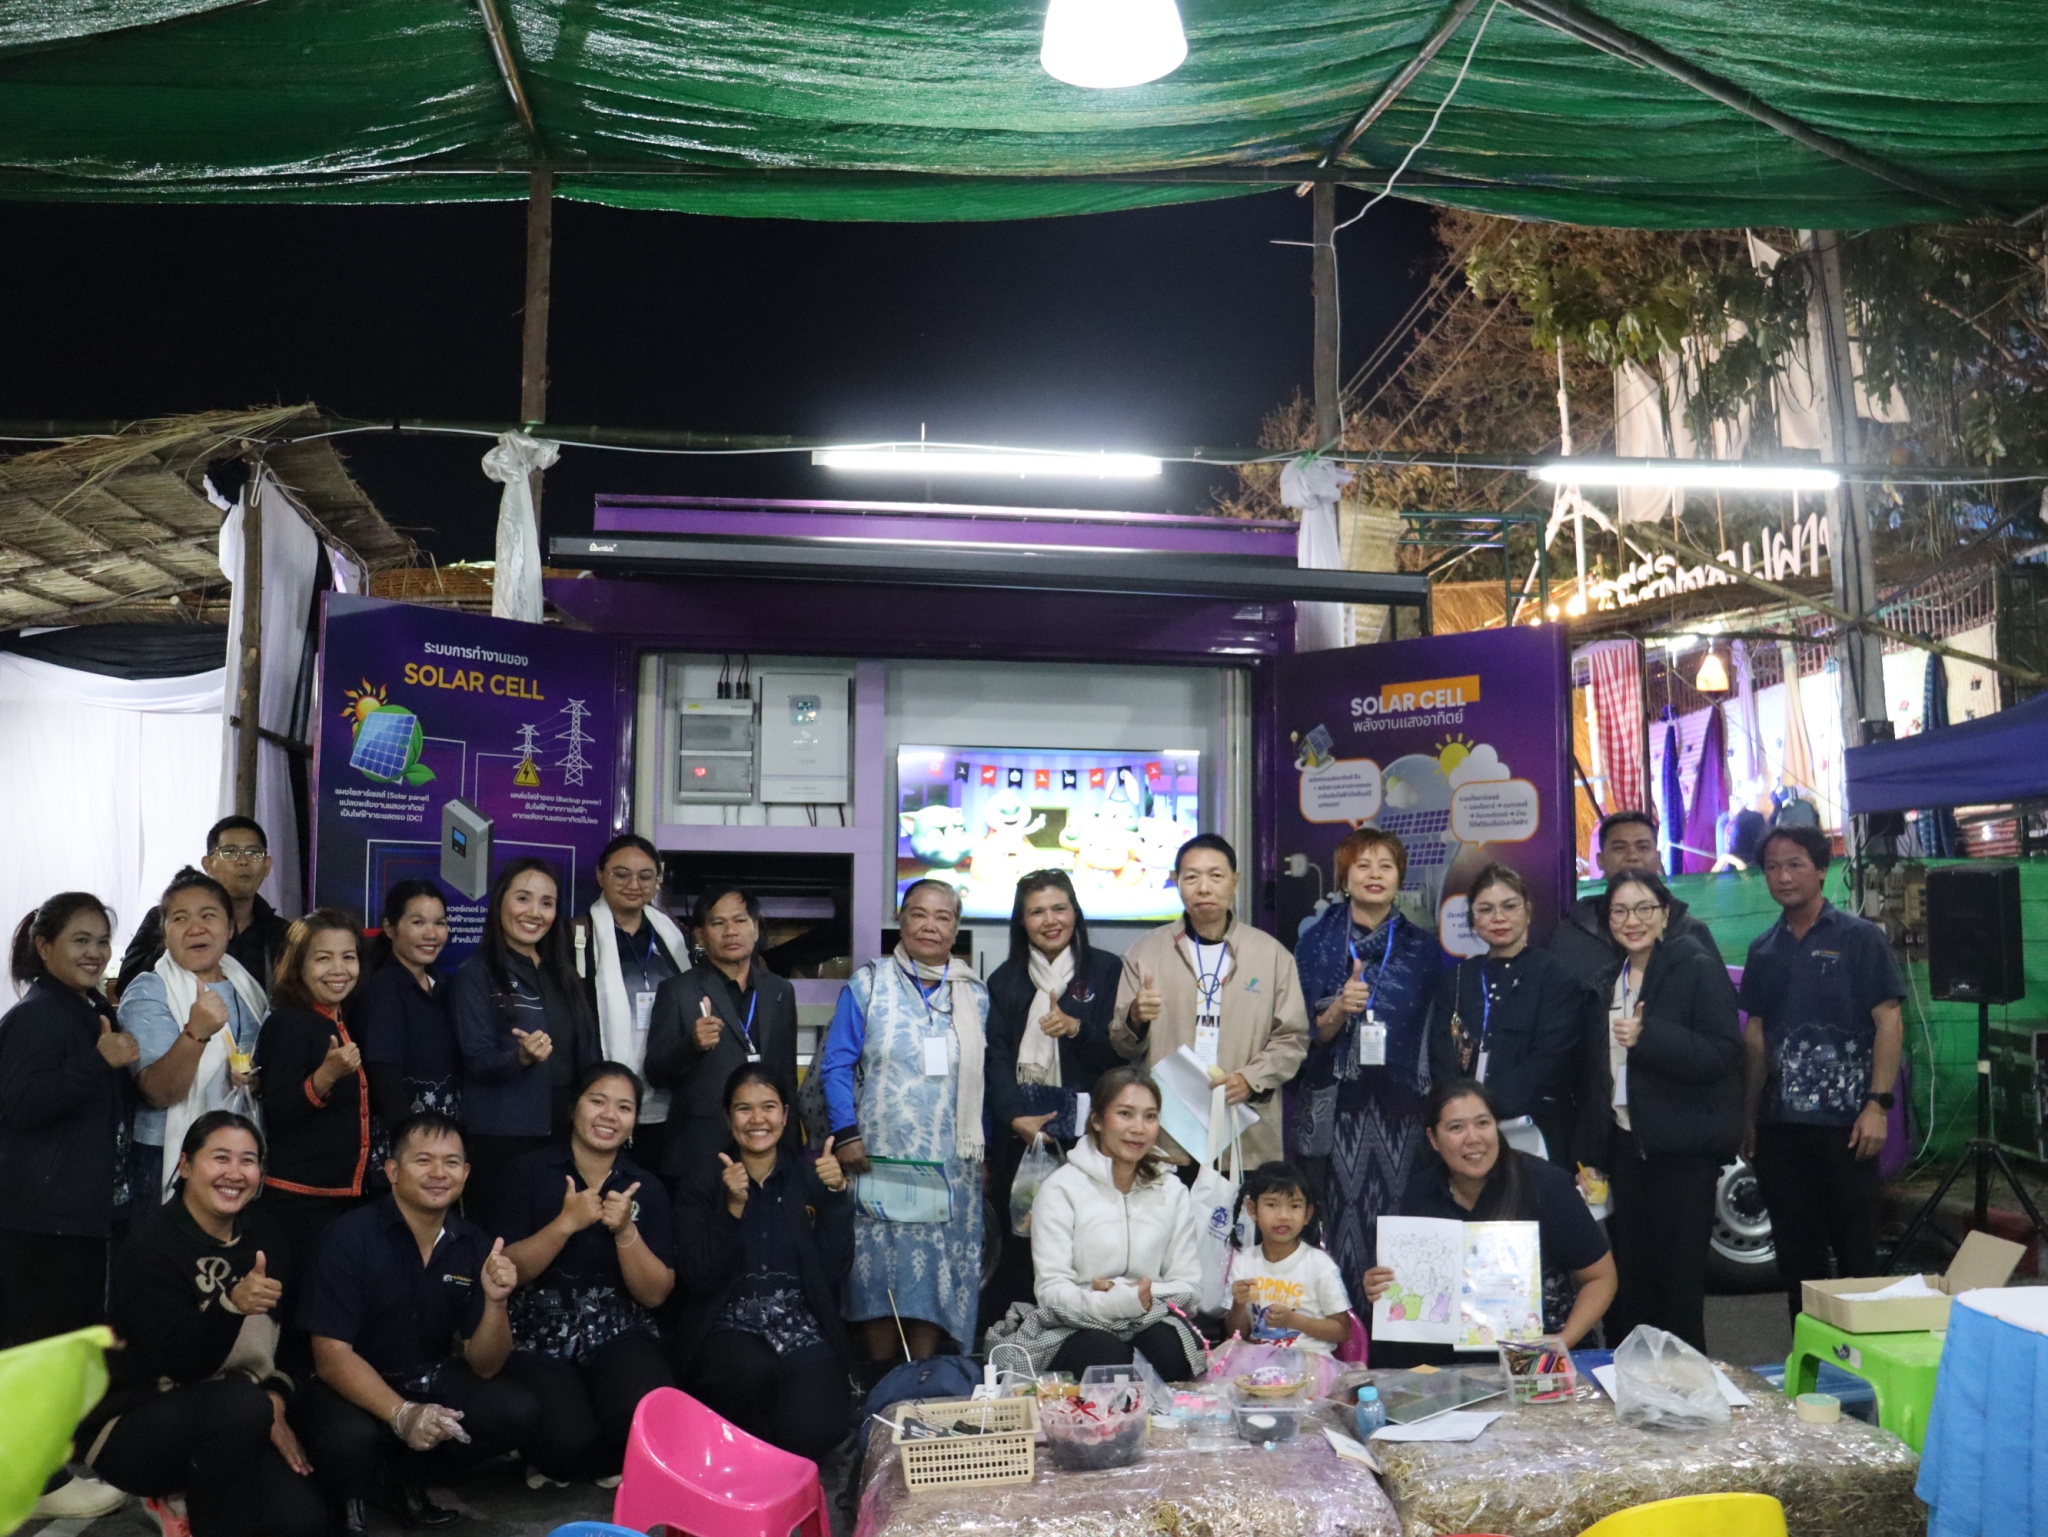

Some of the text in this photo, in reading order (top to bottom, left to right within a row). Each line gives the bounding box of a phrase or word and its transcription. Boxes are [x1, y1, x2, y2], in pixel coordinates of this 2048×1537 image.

[424, 641, 529, 667] ระบบการทำงานของ
[404, 663, 544, 701] SOLAR CELL
[1350, 687, 1466, 717] SOLAR CELL
[1353, 709, 1464, 733] พลังงานแสงอาทิตย์
[387, 792, 407, 801] (Solar
[408, 794, 429, 803] panel)
[406, 813, 423, 823] (DC)
